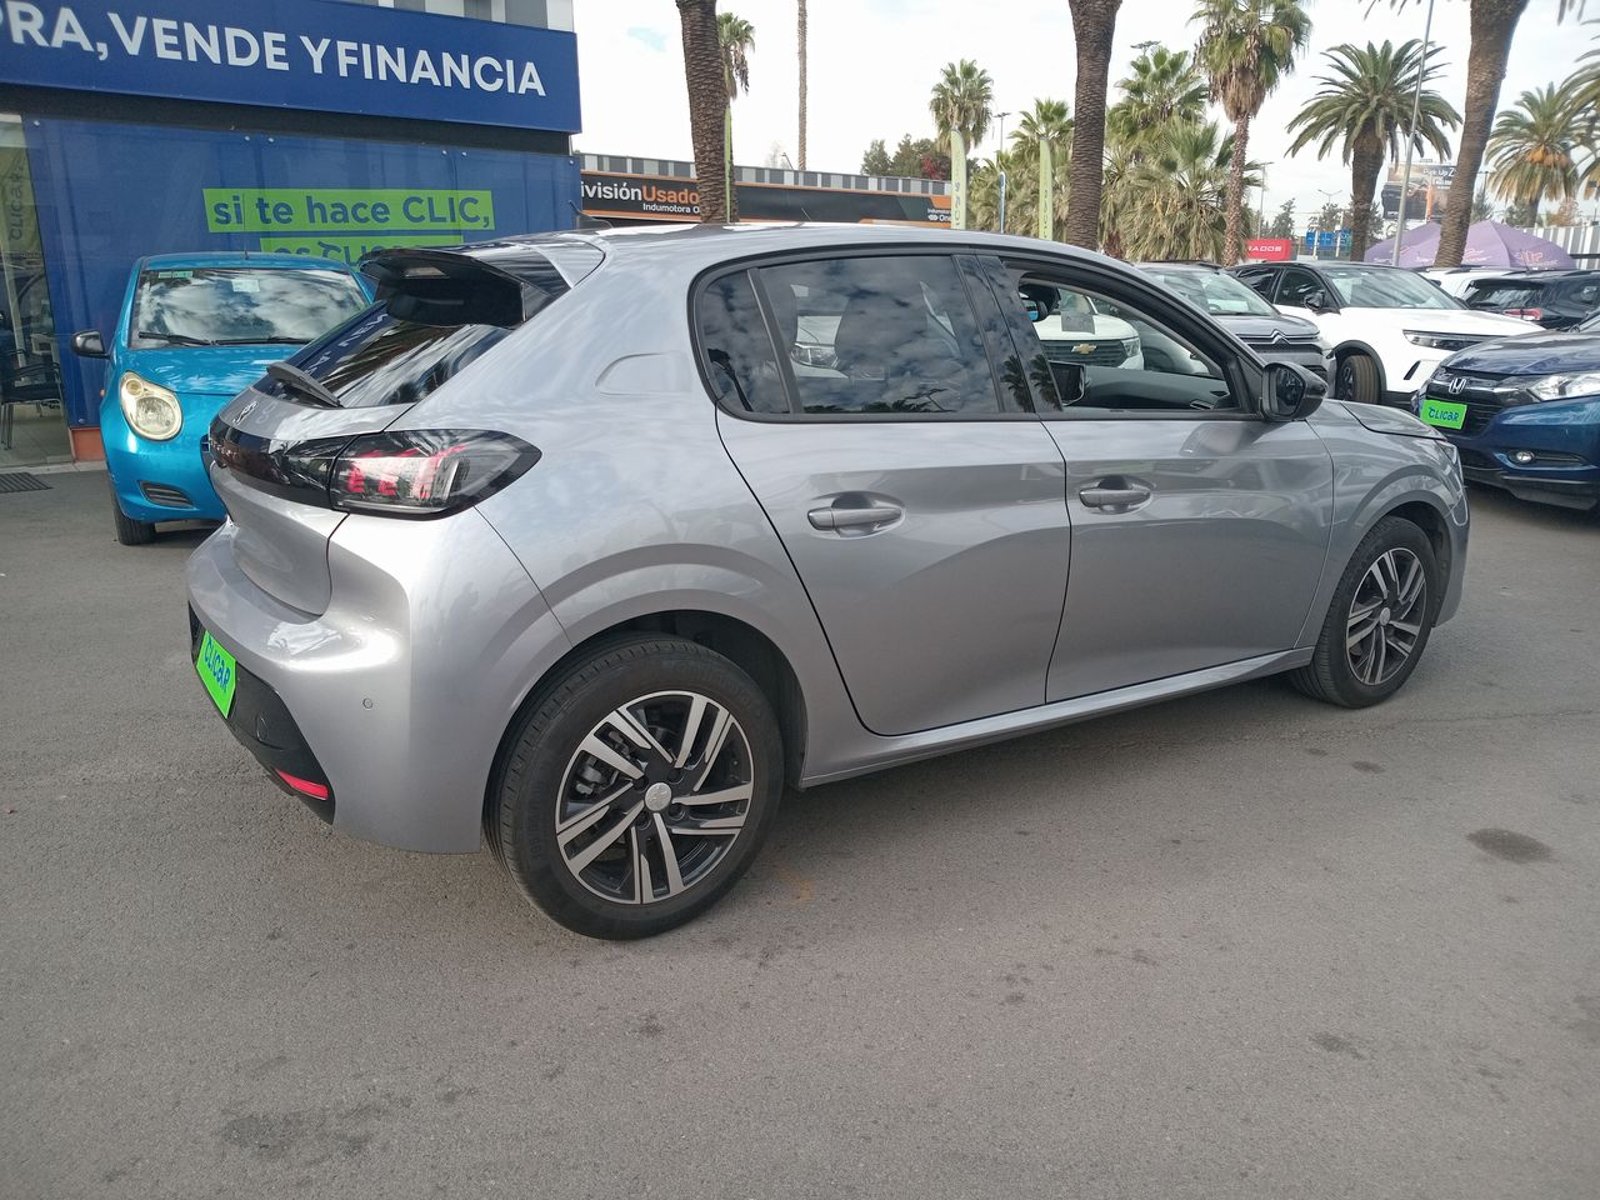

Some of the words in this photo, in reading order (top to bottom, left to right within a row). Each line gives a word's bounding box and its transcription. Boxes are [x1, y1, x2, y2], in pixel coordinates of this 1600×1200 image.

[0, 0, 109, 61] RA,
[107, 12, 290, 71] VENDE
[214, 195, 243, 225] si
[256, 197, 293, 224] te
[306, 196, 391, 224] hace
[402, 196, 490, 228] CLIC,
[642, 202, 691, 213] Indumotora
